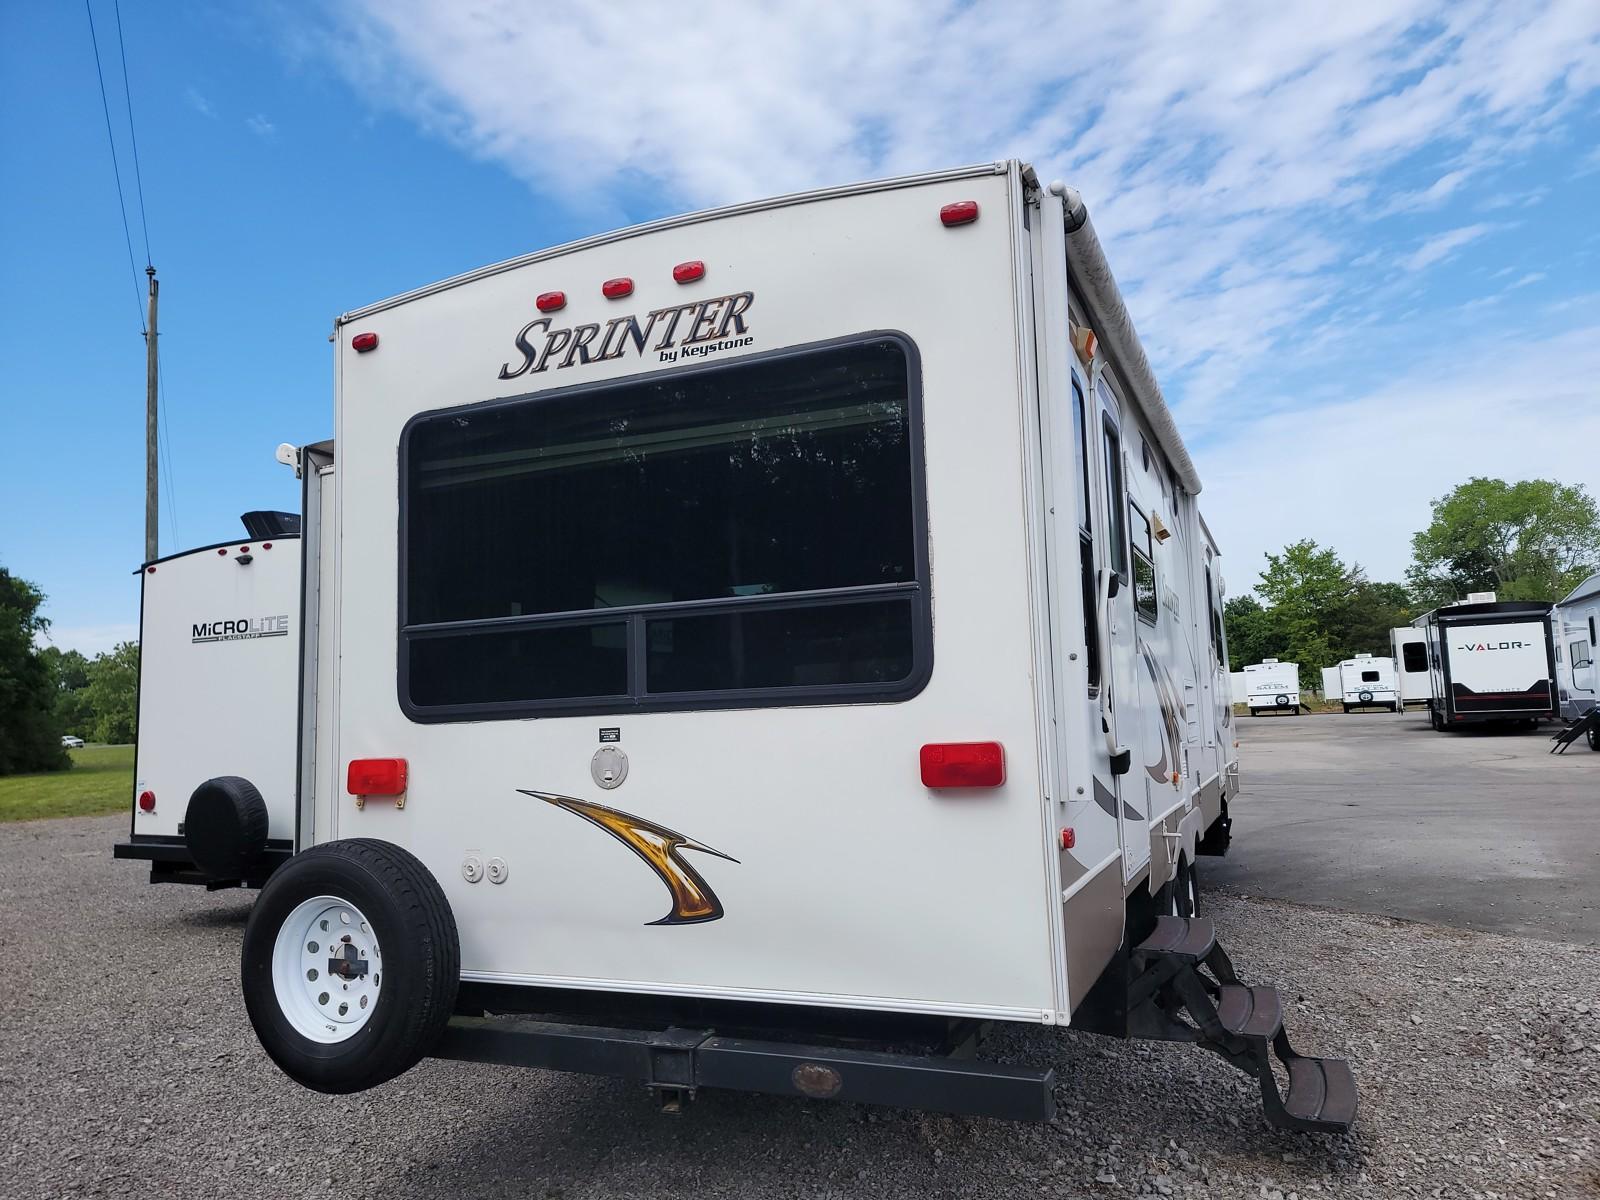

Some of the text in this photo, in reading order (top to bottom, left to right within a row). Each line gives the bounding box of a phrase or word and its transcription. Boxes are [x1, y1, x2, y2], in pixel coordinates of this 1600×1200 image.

[498, 291, 754, 380] SPRINTER
[659, 336, 753, 363] by Keystone
